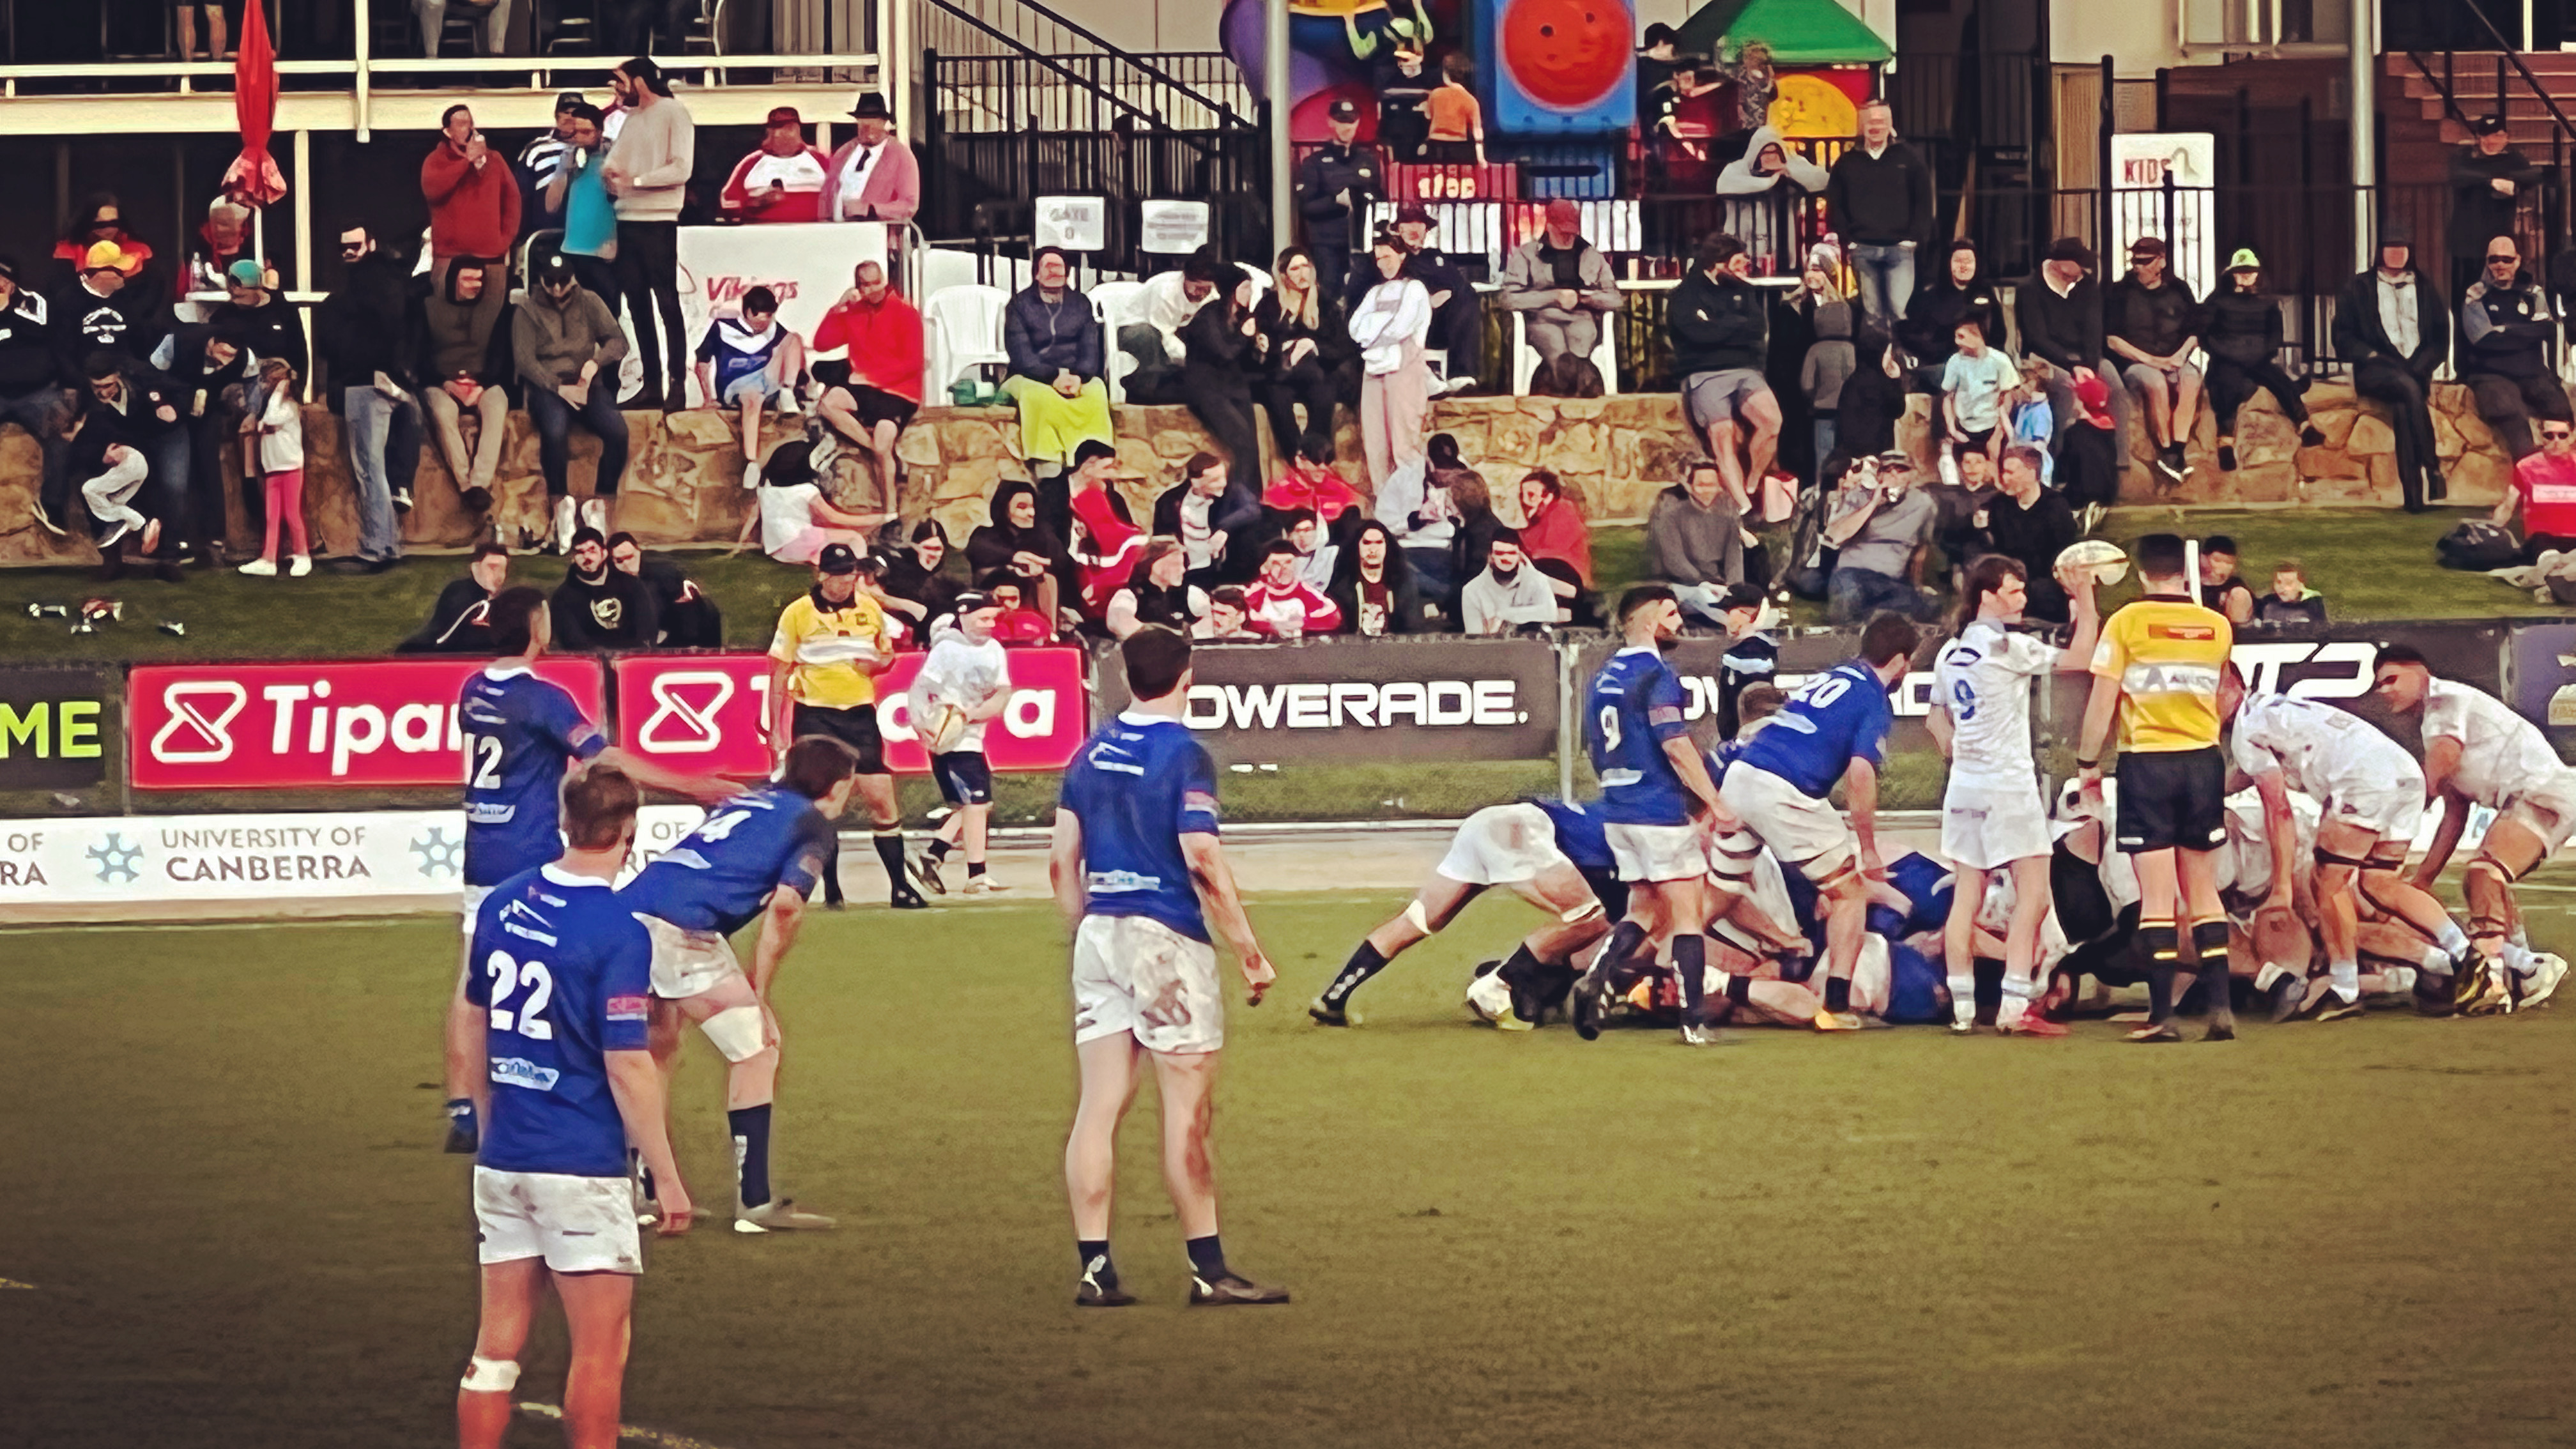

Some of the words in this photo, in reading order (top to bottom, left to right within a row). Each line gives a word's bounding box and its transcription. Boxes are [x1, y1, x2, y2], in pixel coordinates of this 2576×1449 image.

[1182, 680, 1529, 730] OWERADE.
[1954, 679, 1975, 720] 9
[0, 701, 102, 759] ME
[1600, 705, 1621, 754] 9
[8, 832, 44, 853] OF
[161, 827, 322, 848] UNIVERSITY
[330, 826, 366, 846] OF
[165, 855, 372, 882] CANBERRA
[487, 949, 553, 1040] 22
